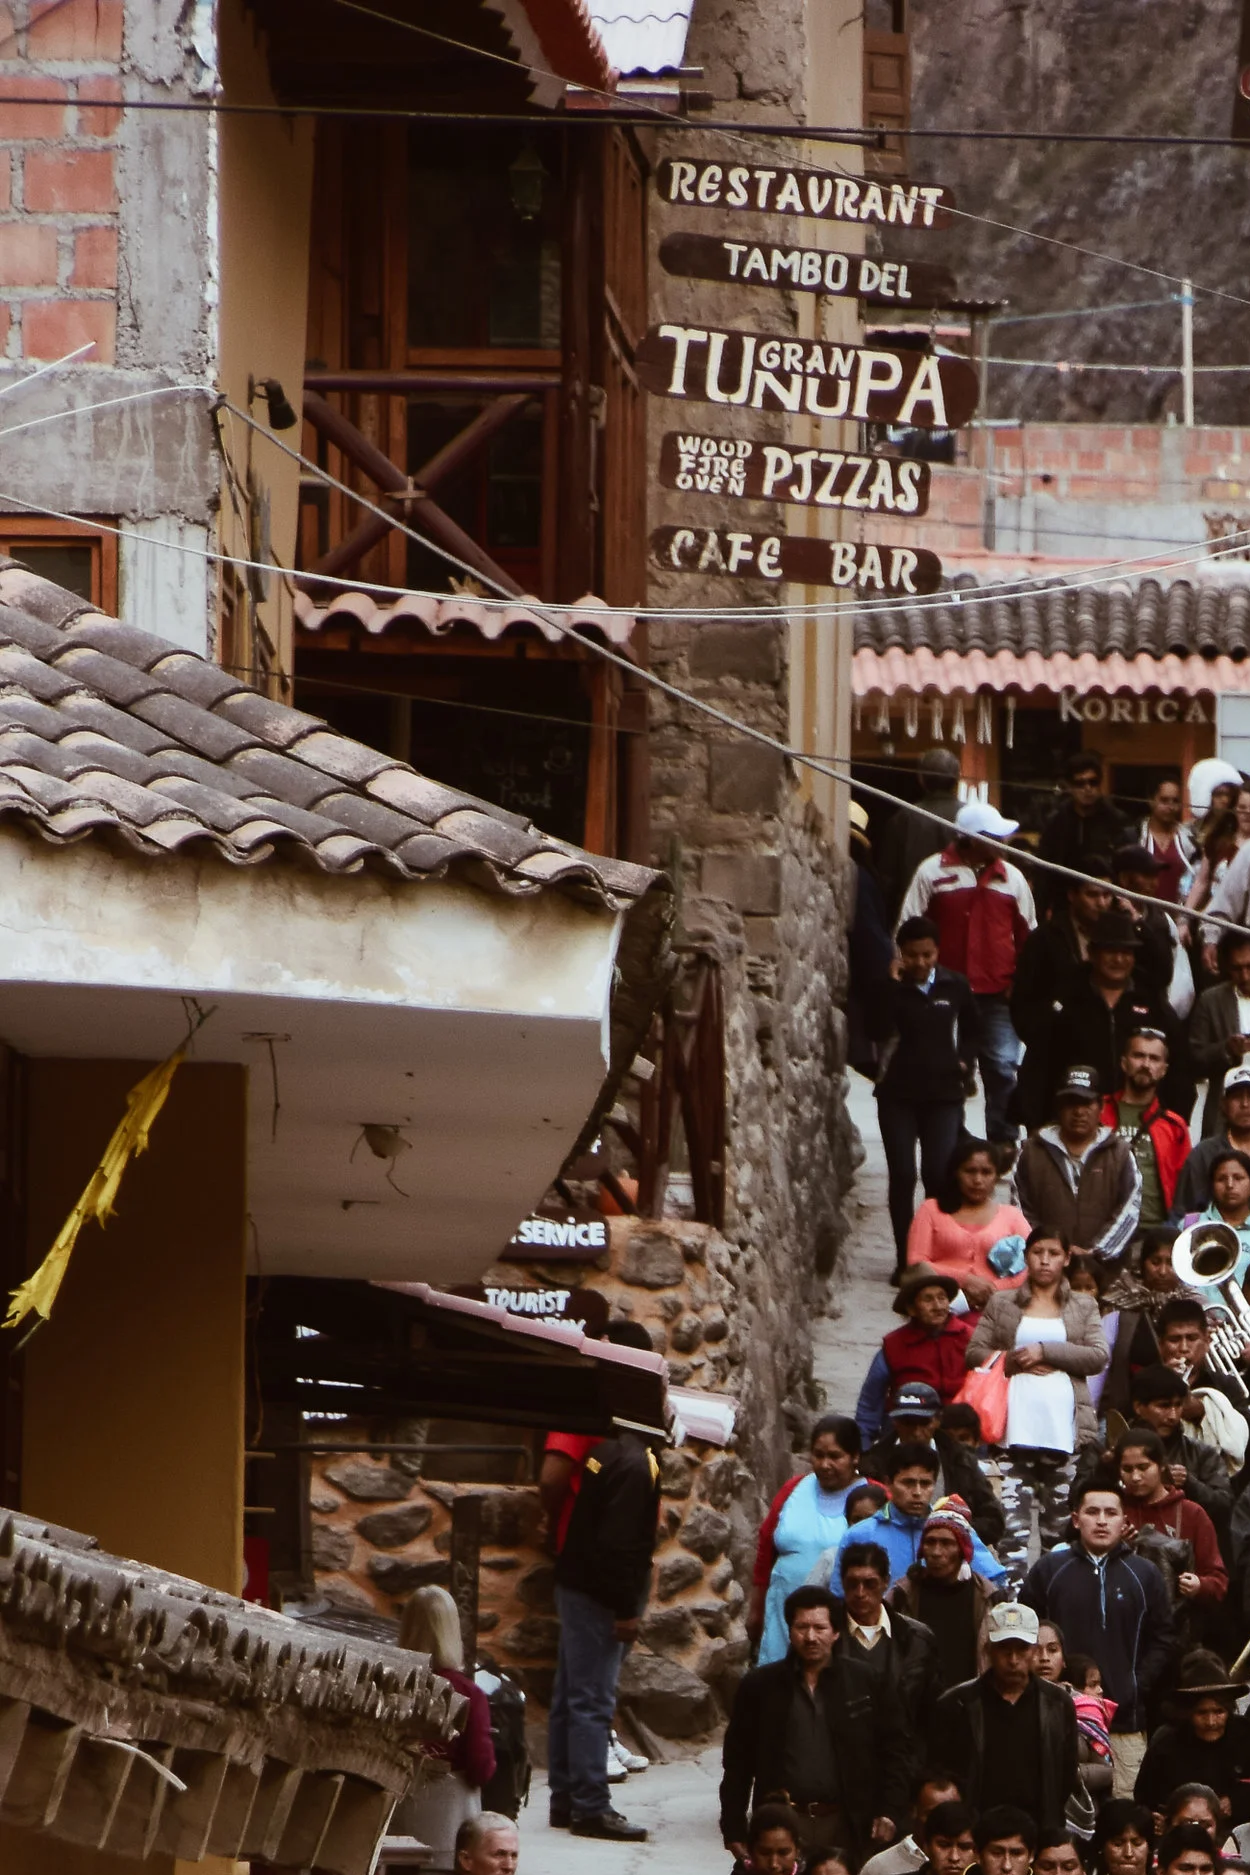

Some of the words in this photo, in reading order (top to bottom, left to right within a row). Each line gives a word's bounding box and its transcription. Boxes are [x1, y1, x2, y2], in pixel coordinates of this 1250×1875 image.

[669, 160, 944, 227] RESTAURANT
[723, 242, 849, 291] TAMBO
[858, 258, 913, 299] DEL
[658, 325, 949, 427] TUNUPA
[758, 339, 857, 378] GRAN
[676, 435, 753, 459] WOOD
[679, 454, 746, 479] FIRE
[676, 474, 745, 496] OVEN
[762, 445, 922, 512] PIZZAS
[669, 529, 783, 577] CAFE
[829, 541, 918, 594] BAR
[1060, 688, 1215, 724] KORICA
